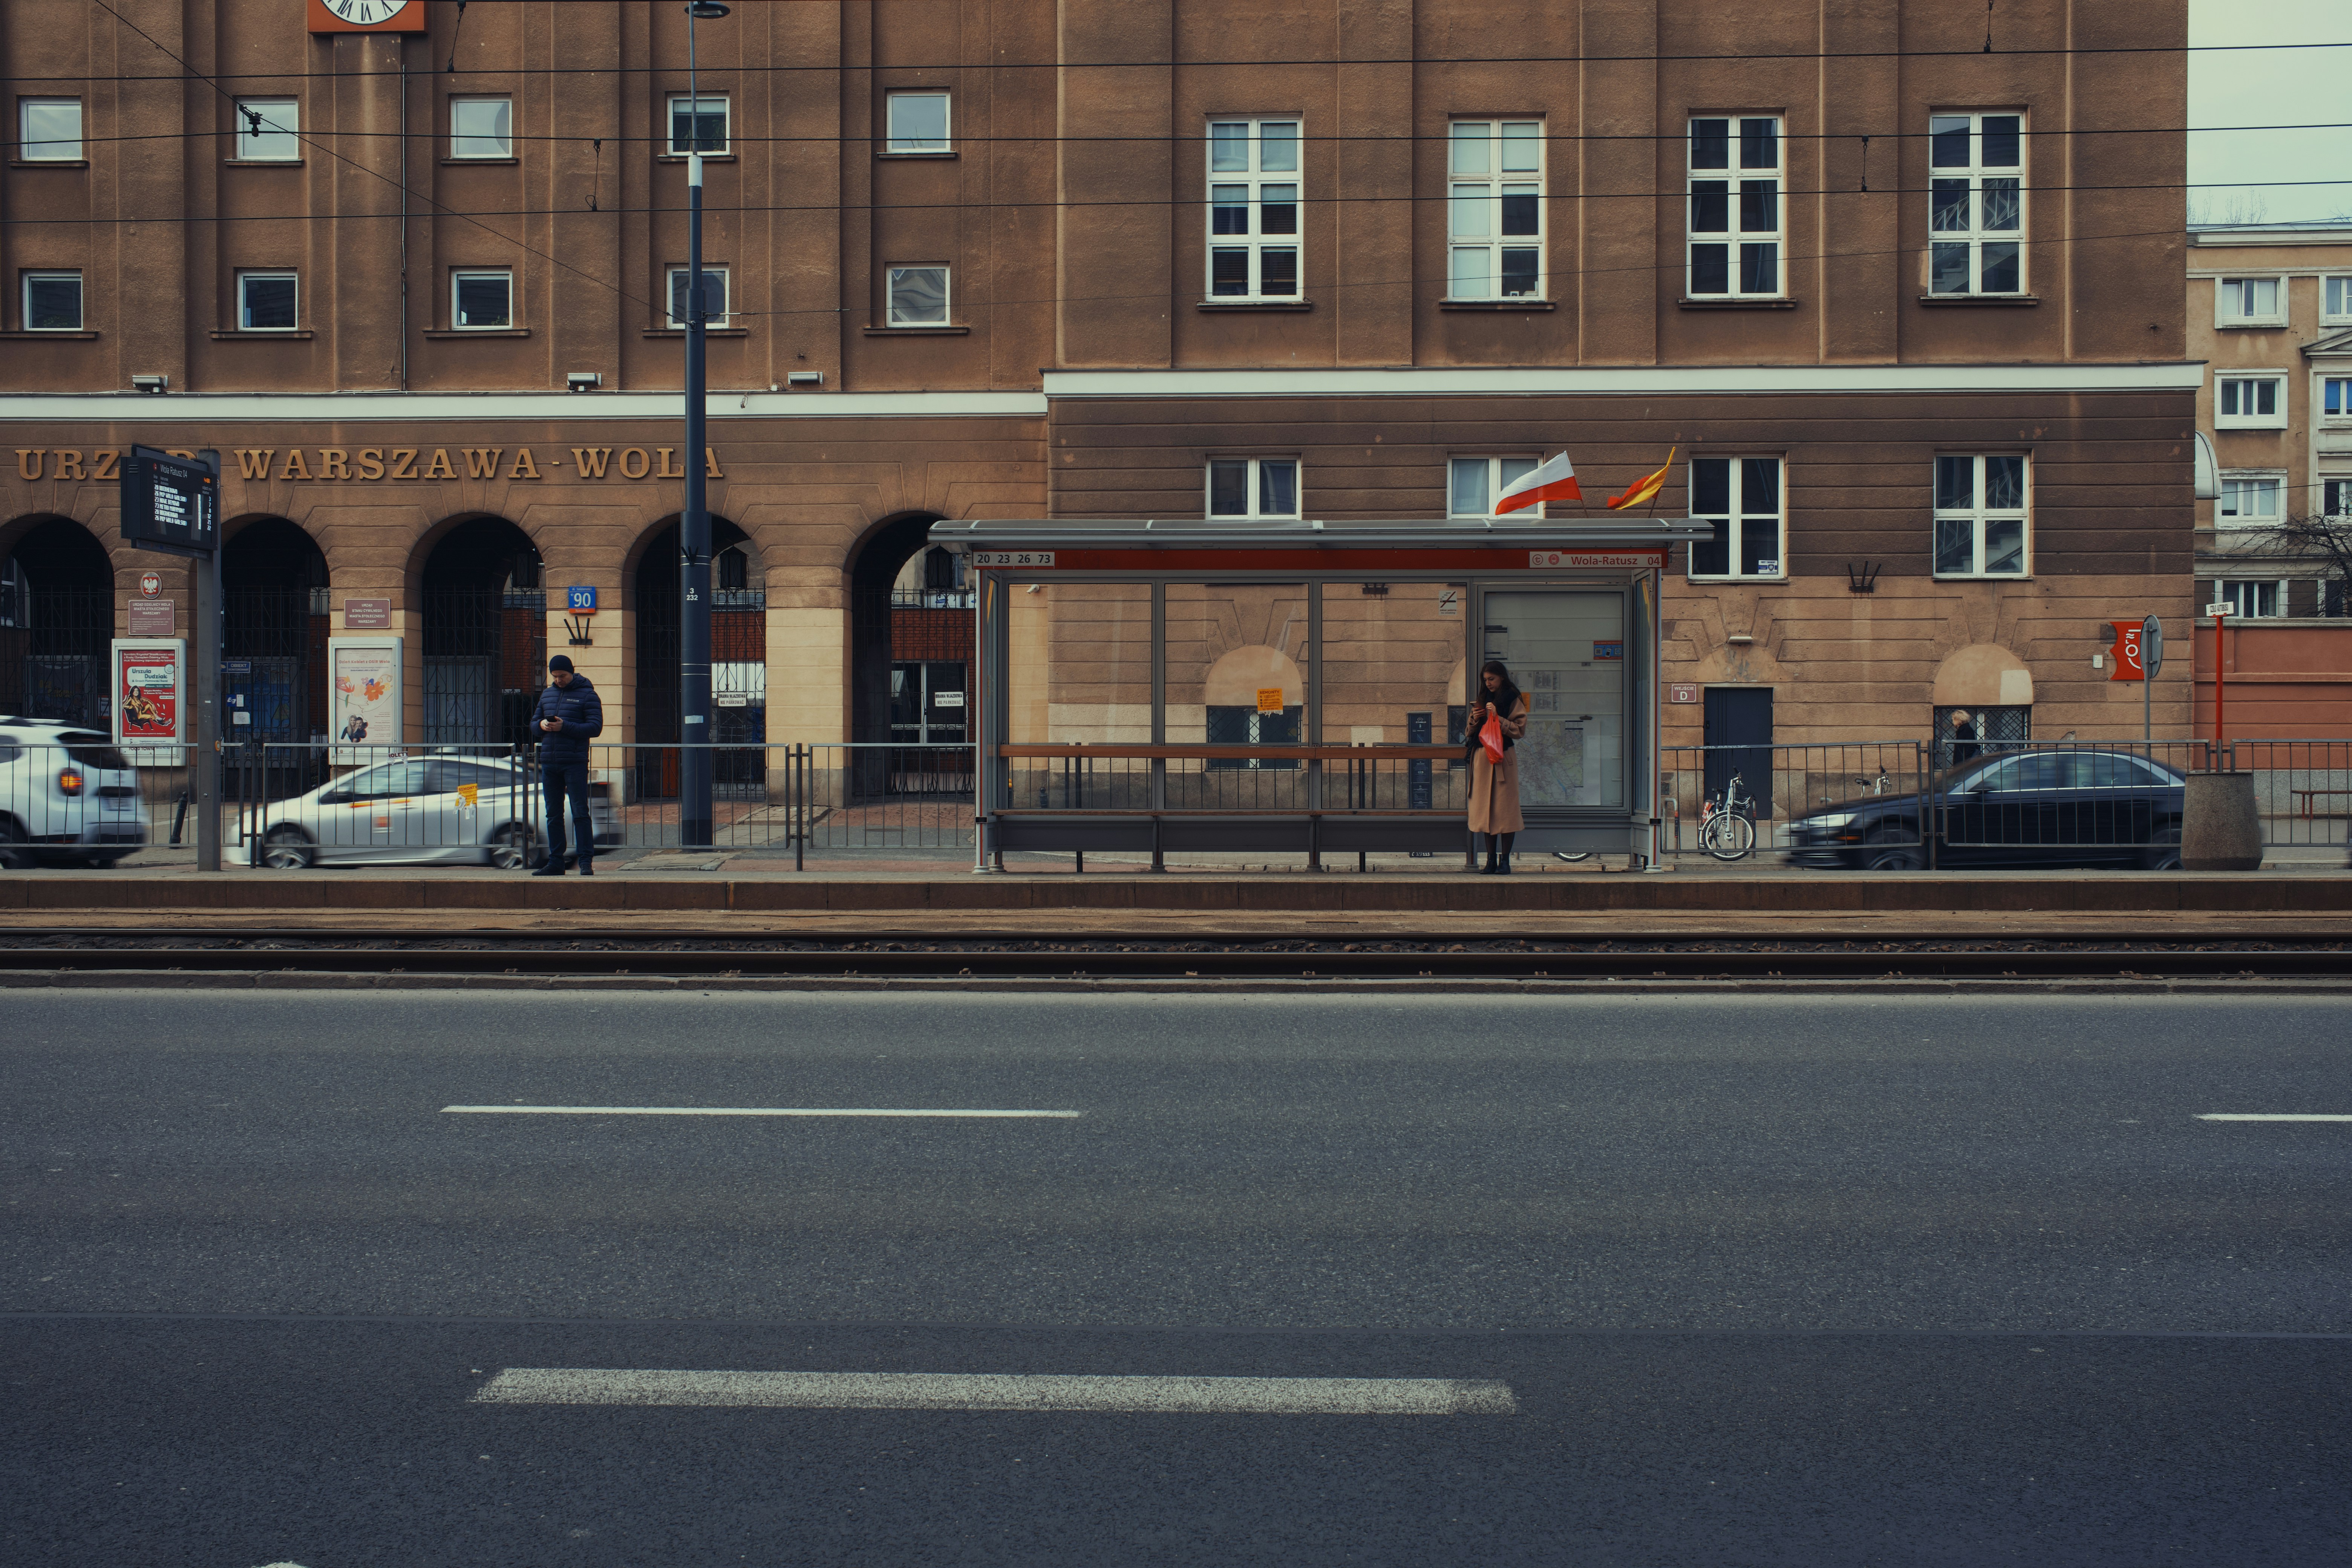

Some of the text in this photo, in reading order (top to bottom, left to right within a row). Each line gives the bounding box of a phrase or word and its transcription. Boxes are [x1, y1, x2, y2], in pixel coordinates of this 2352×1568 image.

[15, 450, 198, 480] URZ
[160, 464, 187, 478] Wola Ratusz 04
[977, 554, 1050, 563] 20 23 26 73
[1571, 556, 1660, 565] Wola-Ratusz 04
[574, 593, 591, 607] 90
[1680, 691, 1687, 700] D
